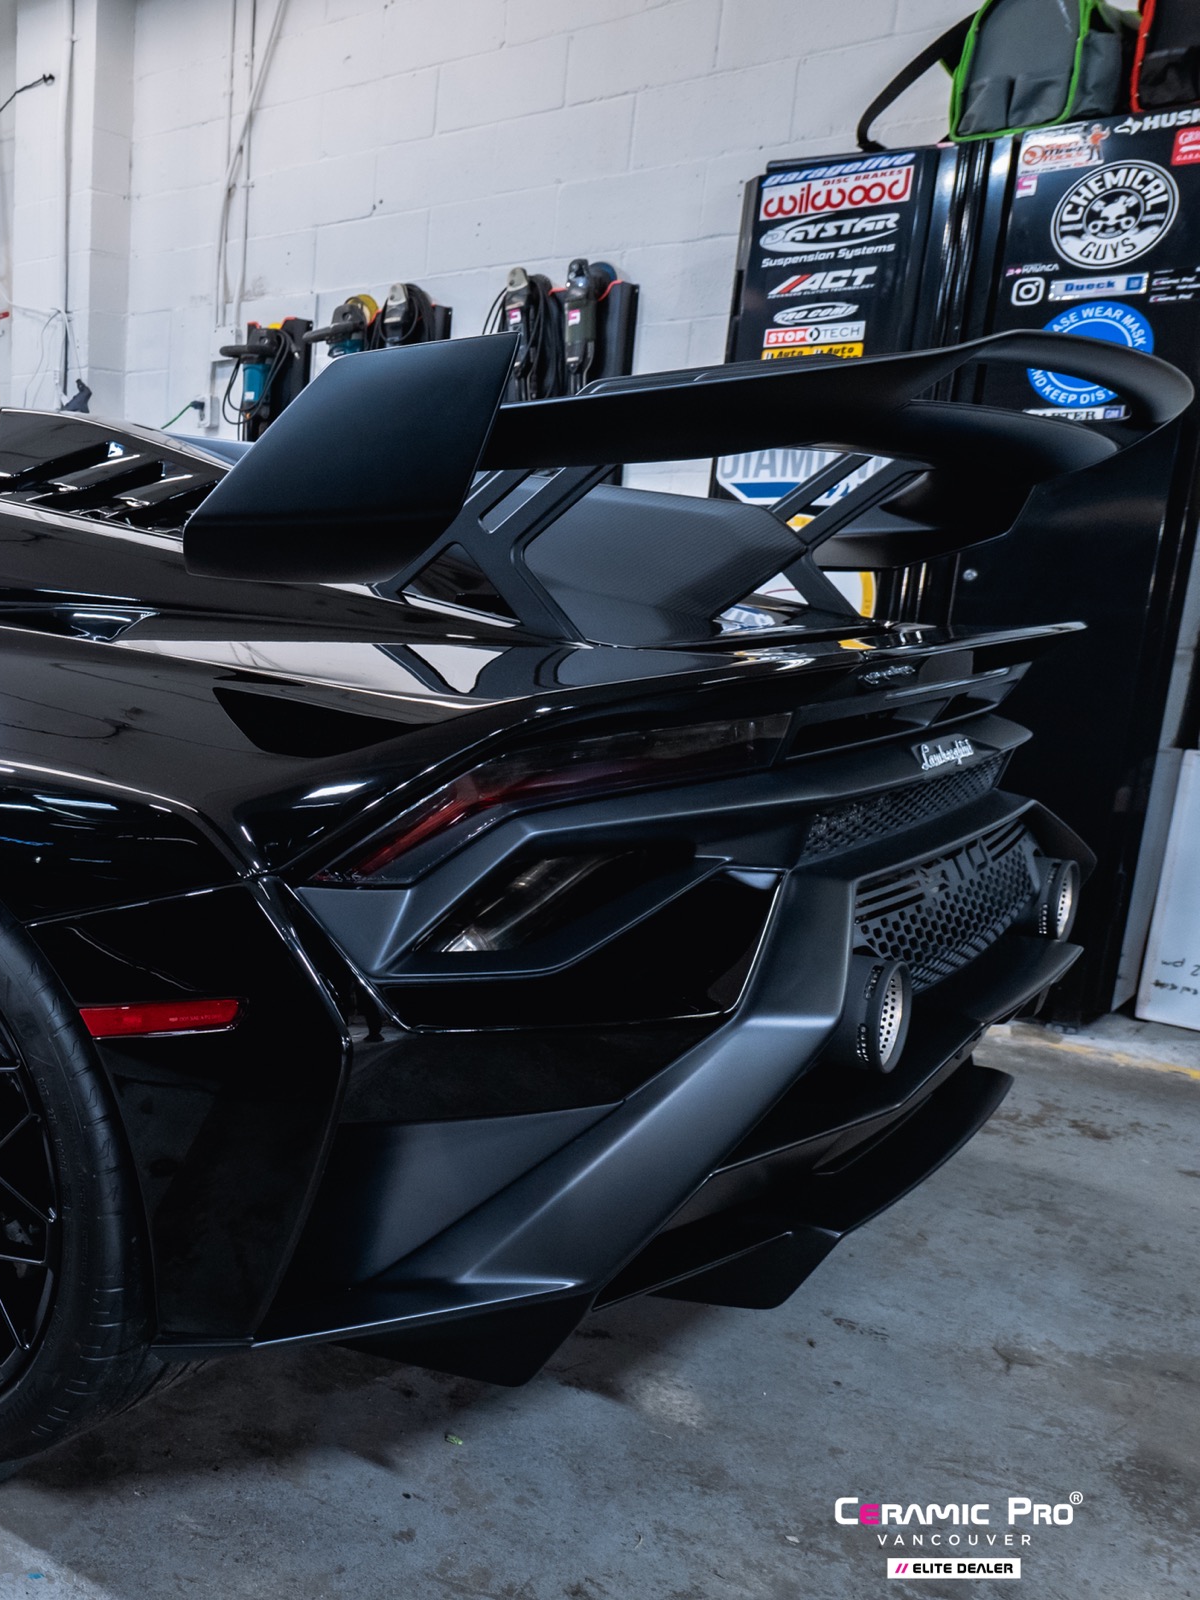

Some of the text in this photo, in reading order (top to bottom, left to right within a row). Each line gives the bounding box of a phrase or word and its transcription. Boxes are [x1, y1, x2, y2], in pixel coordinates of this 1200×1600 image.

[822, 168, 903, 187] DISC BRAKES
[763, 167, 912, 218] wilwood
[1061, 168, 1169, 222] CHEMICAL
[763, 212, 900, 246] DAYSTAR
[761, 243, 896, 268] Suspension Systems
[1079, 237, 1137, 261] GUYS
[1065, 280, 1115, 292] Dueck
[768, 326, 860, 343] STOP TECH
[1082, 306, 1124, 320] WEAR
[1121, 314, 1147, 347] MASK
[827, 346, 854, 354] Auto
[1032, 368, 1048, 387] ND
[1042, 384, 1077, 404] KEEP
[921, 738, 975, 771] Lamborghini
